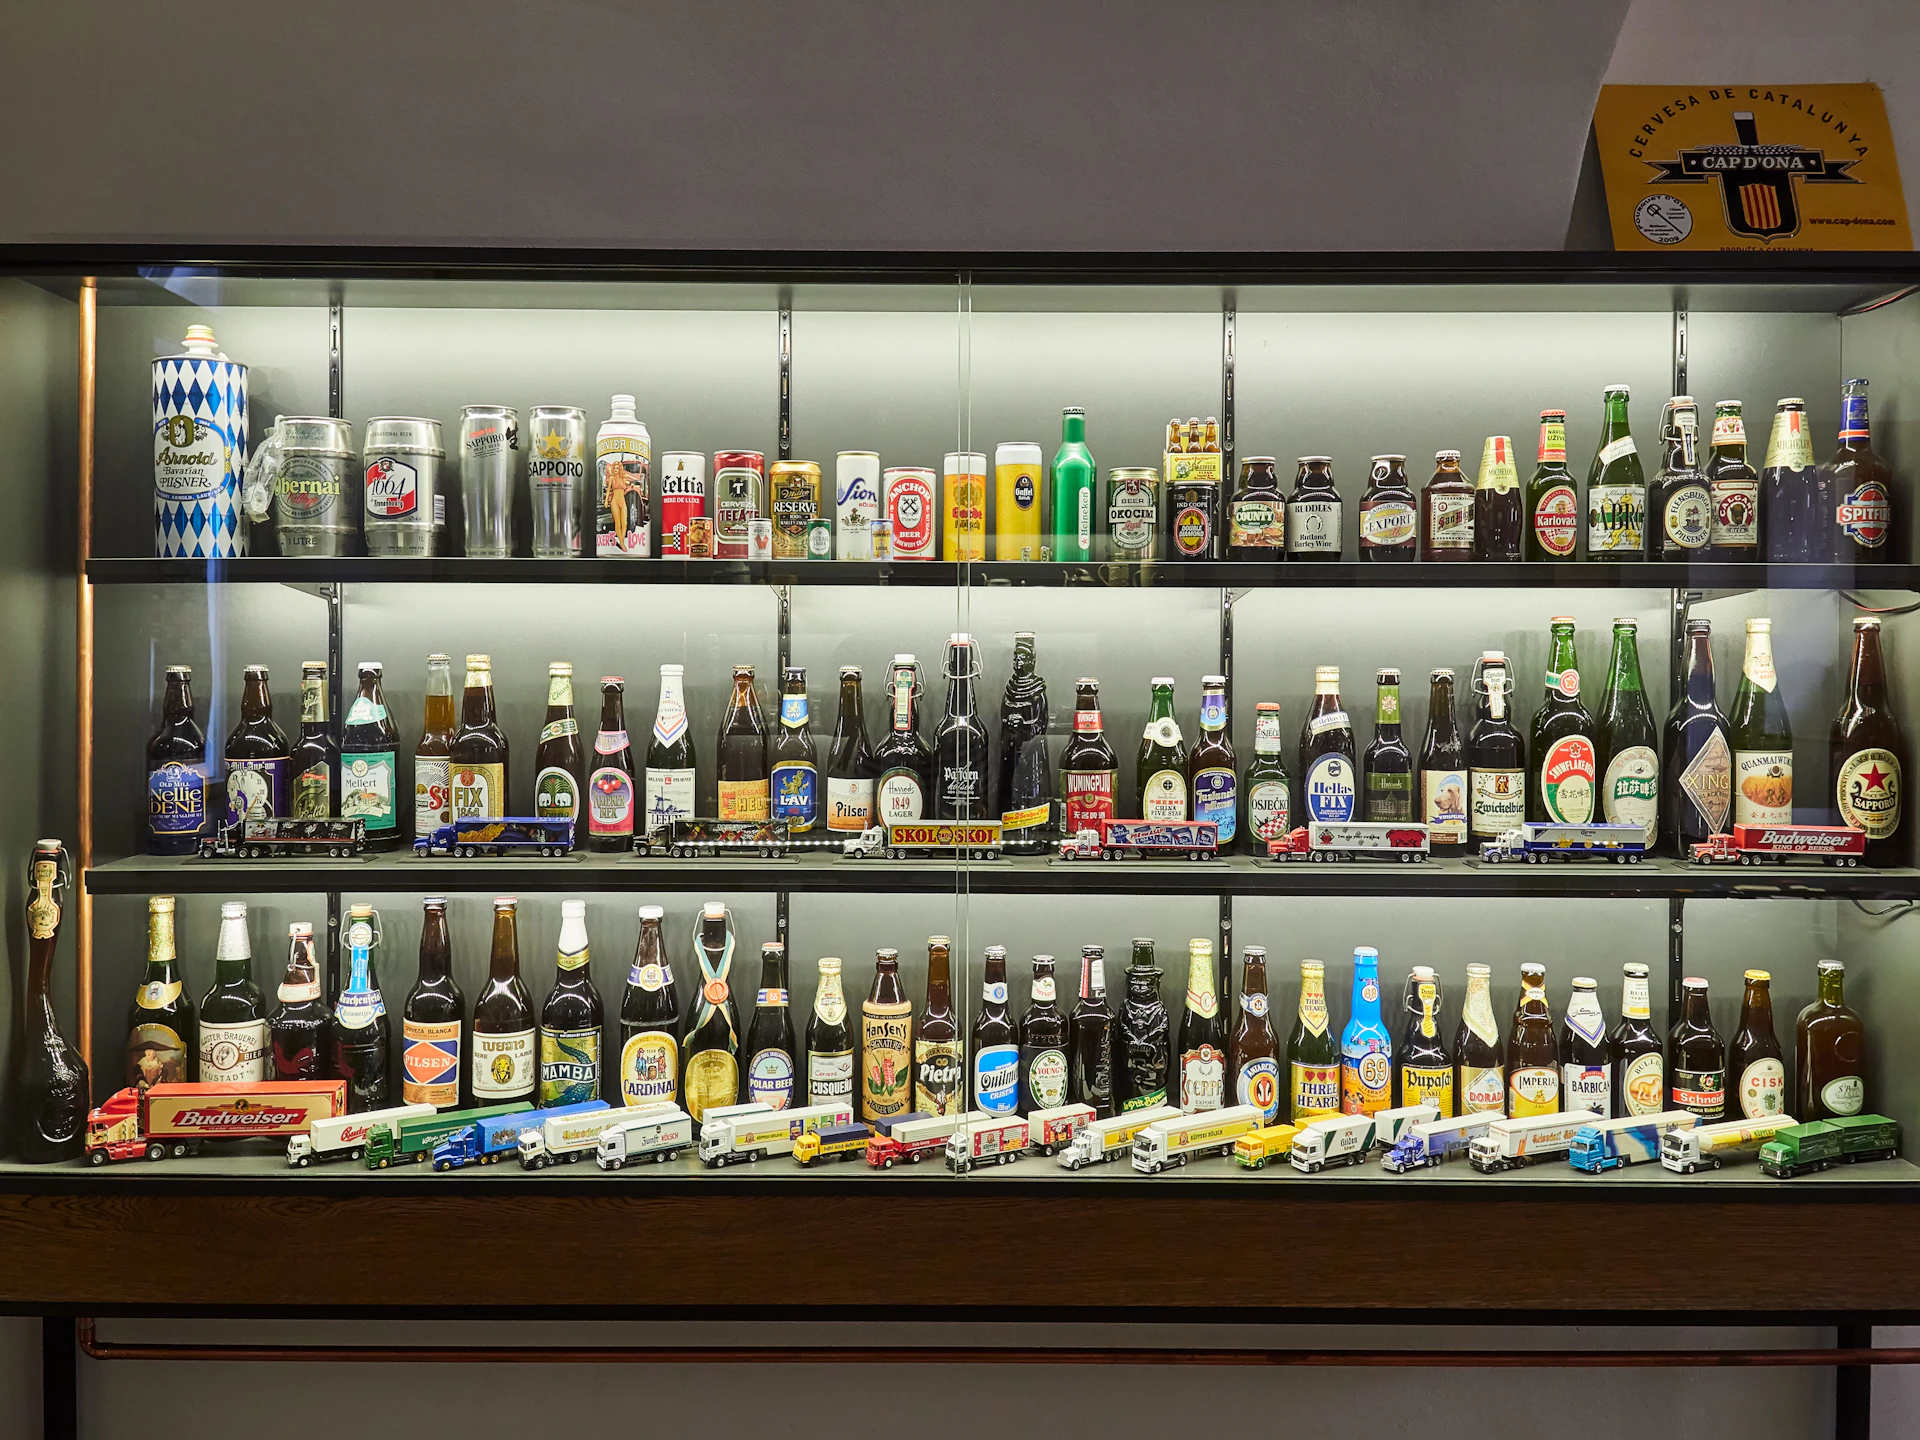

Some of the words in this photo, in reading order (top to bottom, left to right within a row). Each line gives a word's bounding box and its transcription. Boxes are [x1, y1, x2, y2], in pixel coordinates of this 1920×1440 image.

[1629, 94, 1701, 158] CERVESA
[1710, 88, 1736, 100] DE
[1749, 88, 1869, 158] CATALUNYA
[1809, 216, 1896, 227] www.cap-dona.com
[467, 432, 505, 450] SAPPORO
[156, 446, 219, 466] Arnold
[163, 467, 205, 477] Bavarian
[529, 460, 583, 477] SAPPORO
[159, 478, 212, 488] PILSNER
[371, 474, 407, 499] 1664
[662, 475, 703, 495] Celtia
[837, 477, 877, 506] Sion
[890, 482, 931, 502] ANCHOR
[774, 502, 817, 513] RESERVE
[1295, 505, 1332, 513] RUDDLES
[1368, 503, 1408, 515] SAINSBURY'S
[1671, 491, 1711, 515] FLENSBURGER
[1718, 497, 1753, 518] CALGARY
[718, 509, 760, 522] TECATE
[1111, 508, 1154, 519] OKOCIM
[1236, 512, 1274, 521] COUNTY
[1369, 516, 1411, 531] EXPORT
[1437, 515, 1455, 529] San
[293, 538, 318, 546] LITRE
[627, 531, 646, 548] LOVE
[1674, 529, 1708, 543] PILSENER
[1549, 760, 1585, 779] SNOWFLAKE
[345, 779, 377, 788] Mellert
[887, 783, 915, 795] Harrods
[1314, 782, 1352, 794] Hellas
[151, 787, 202, 802] Nellie
[454, 788, 481, 807] FIX
[780, 795, 808, 806] LAV
[151, 802, 202, 814] DENE
[892, 797, 910, 810] 1849
[1252, 797, 1288, 810] OSJEČKO
[1320, 795, 1347, 808] FIX
[1853, 797, 1895, 810] SAPPORO
[894, 830, 936, 842] SKOL
[1759, 831, 1852, 847] Budweiser
[869, 1040, 902, 1051] SIGNATURE
[244, 1051, 262, 1061] BIER
[404, 1054, 451, 1068] PILSEN
[542, 1066, 594, 1081] MAMBA
[920, 1063, 961, 1083] Pietra
[1037, 1066, 1064, 1074] YOUNG'S
[750, 1079, 774, 1088] POLAR
[775, 1078, 793, 1087] BEER
[812, 1078, 852, 1096] CUSQUEÑA
[1300, 1082, 1337, 1095] THREE
[990, 1088, 1014, 1100] CRISTAL
[1297, 1095, 1339, 1108] HEARTS
[177, 1111, 298, 1126] Budweiser
[661, 1132, 679, 1142] KÖLSCH
[1191, 1133, 1208, 1141] KÜPPERS
[1340, 1137, 1358, 1146] Gilden
